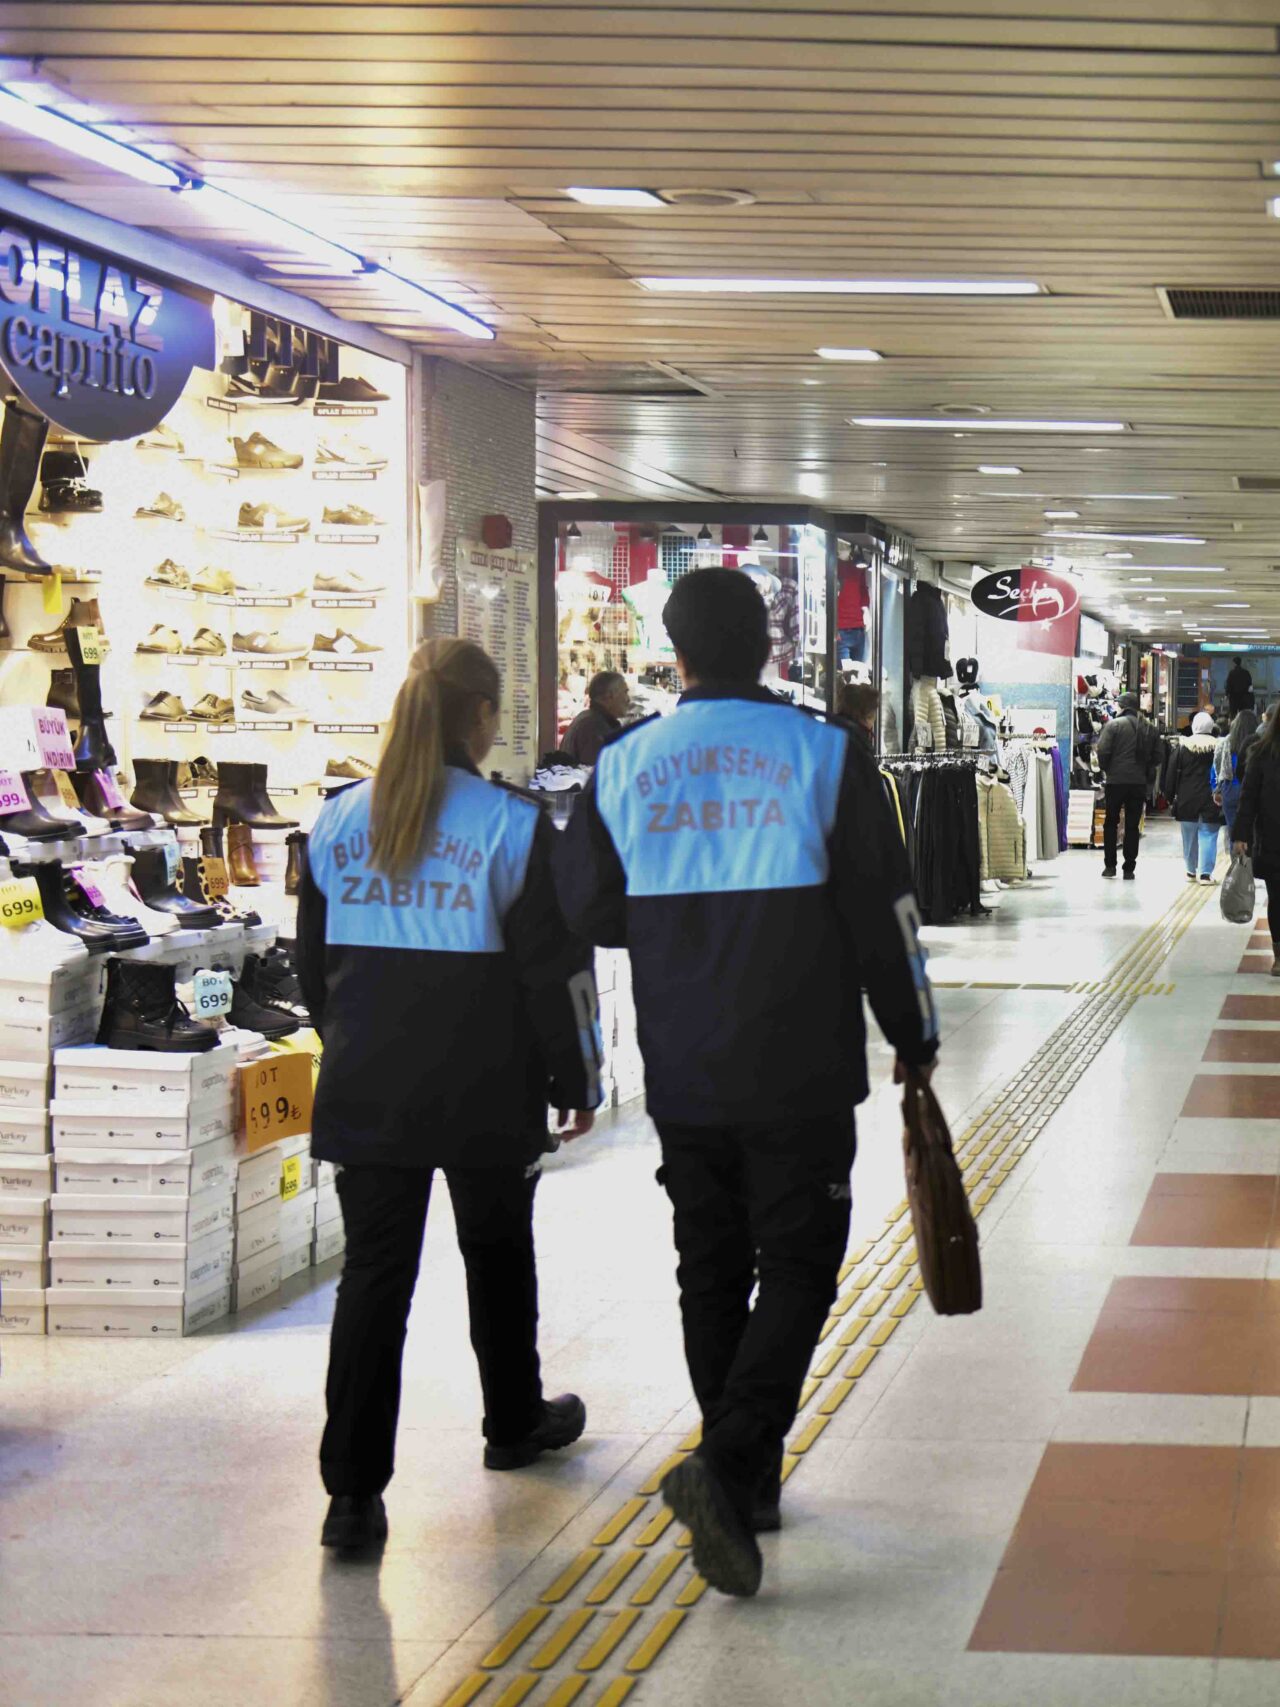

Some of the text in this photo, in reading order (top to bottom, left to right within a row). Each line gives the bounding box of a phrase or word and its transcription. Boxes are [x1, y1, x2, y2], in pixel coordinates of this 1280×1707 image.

[8, 316, 157, 400] caprito
[38, 716, 65, 736] BÜYÜK
[43, 748, 74, 767] İNDİRİM
[636, 743, 793, 797] BÜYÜKŞEHİR
[648, 797, 786, 833] ZABITA
[333, 828, 484, 879] BÜEHİR
[210, 877, 225, 889] 699
[341, 876, 476, 912] ZABITA
[1, 1176, 32, 1188] Turkey
